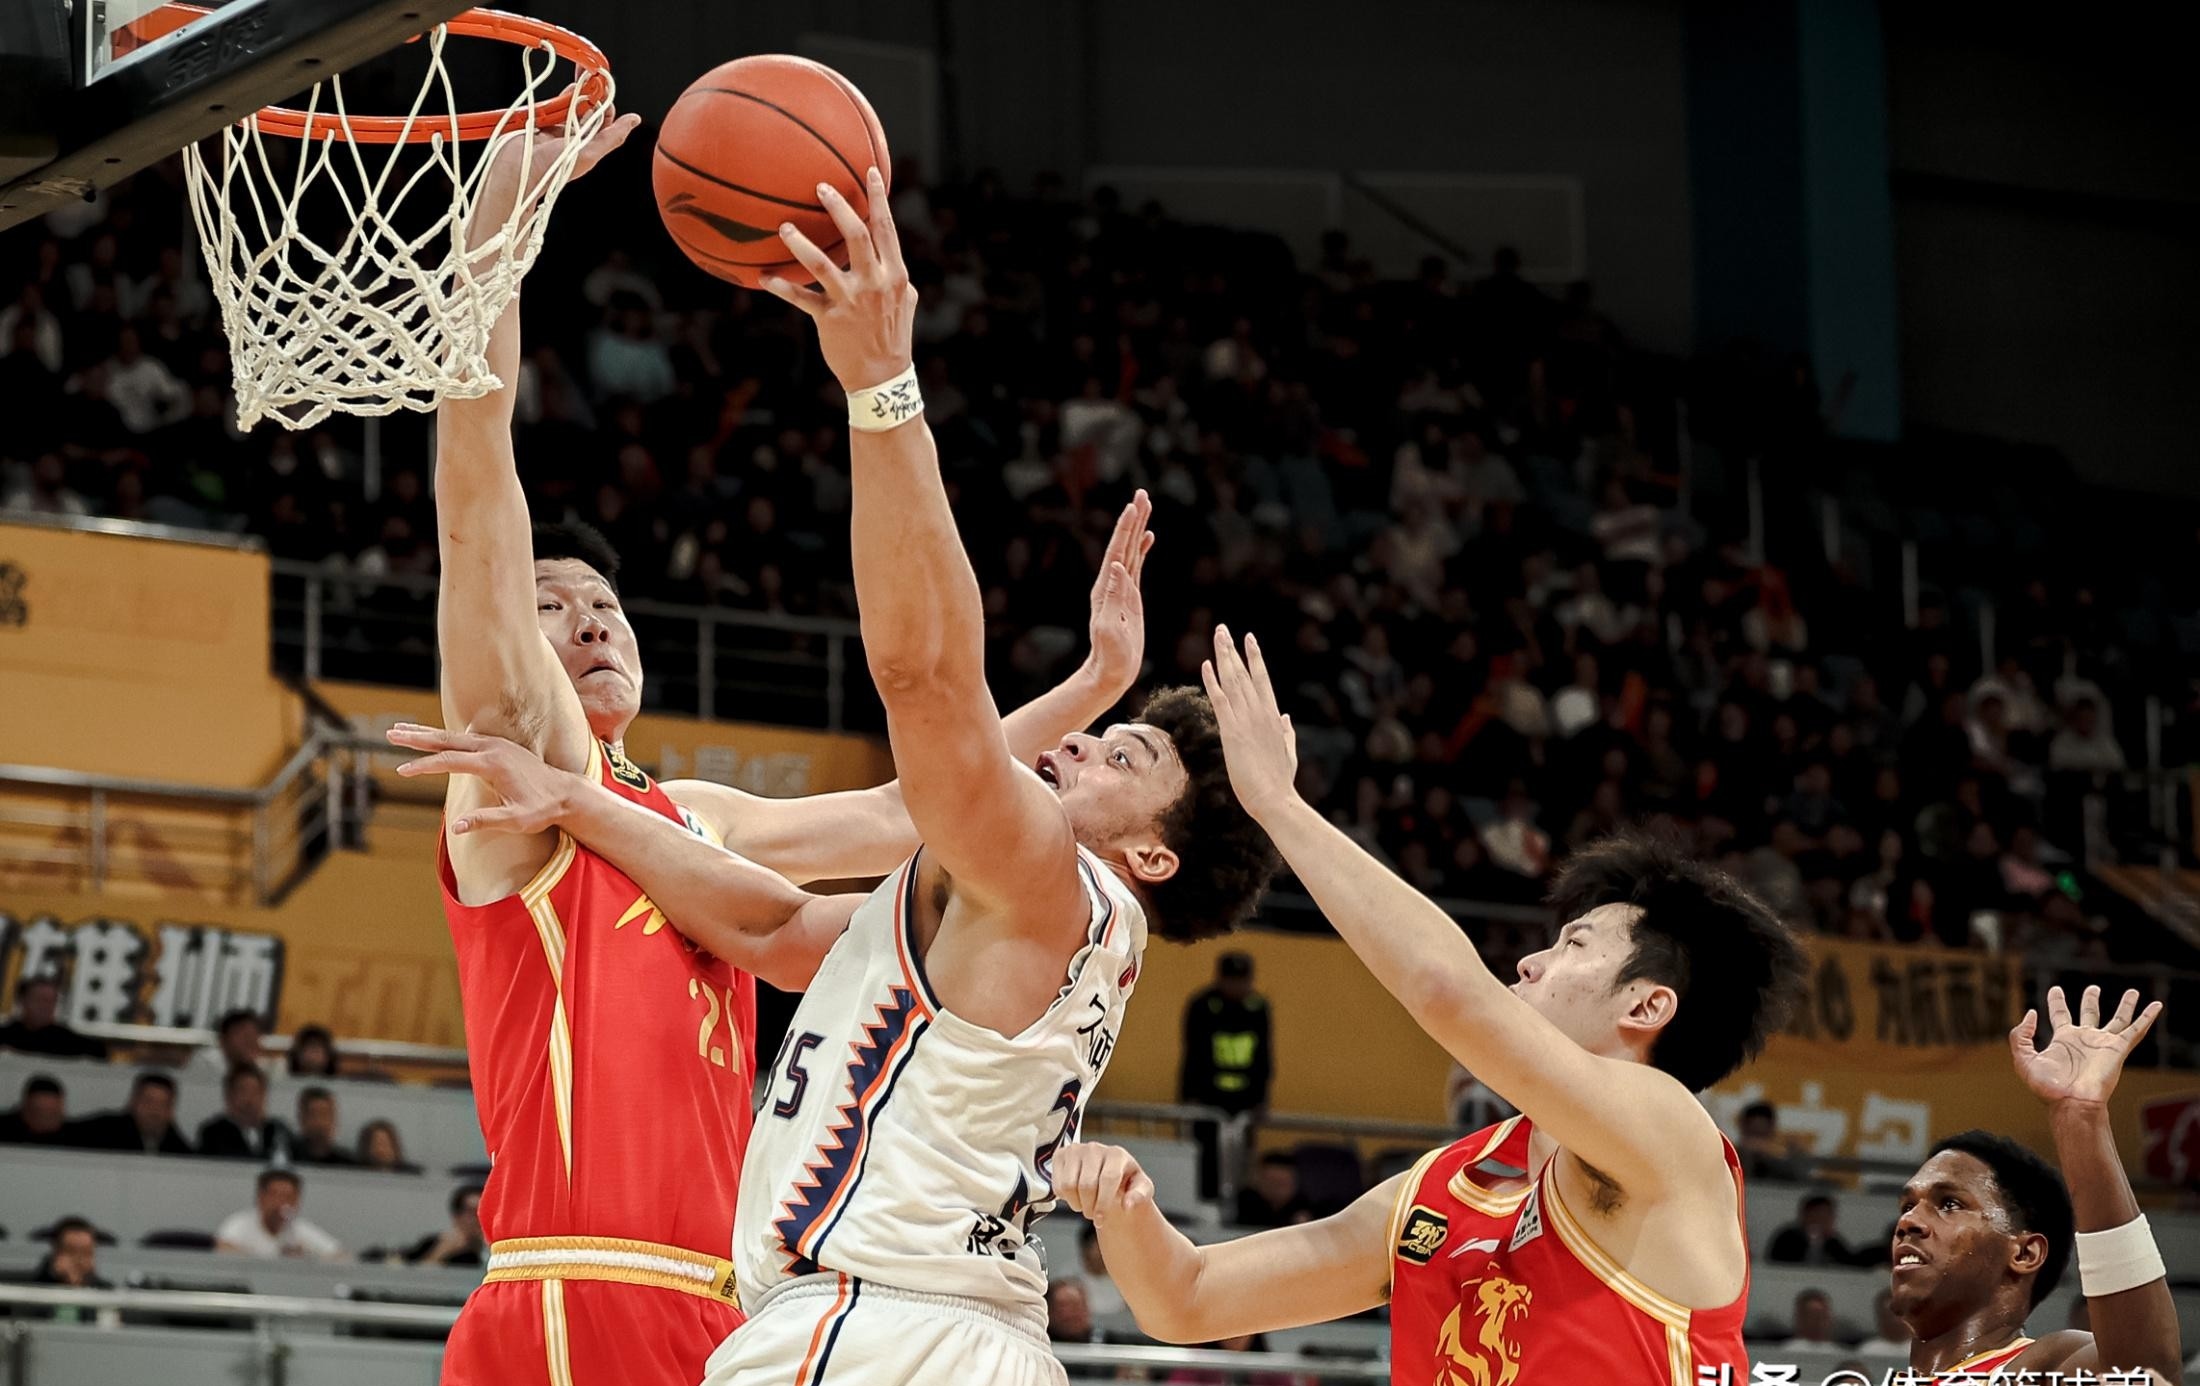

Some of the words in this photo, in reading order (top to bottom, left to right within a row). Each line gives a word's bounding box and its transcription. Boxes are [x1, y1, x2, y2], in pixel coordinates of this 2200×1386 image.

[0, 915, 283, 1034] 雄狮
[689, 978, 740, 1075] 21
[1407, 1241, 1432, 1257] CBA
